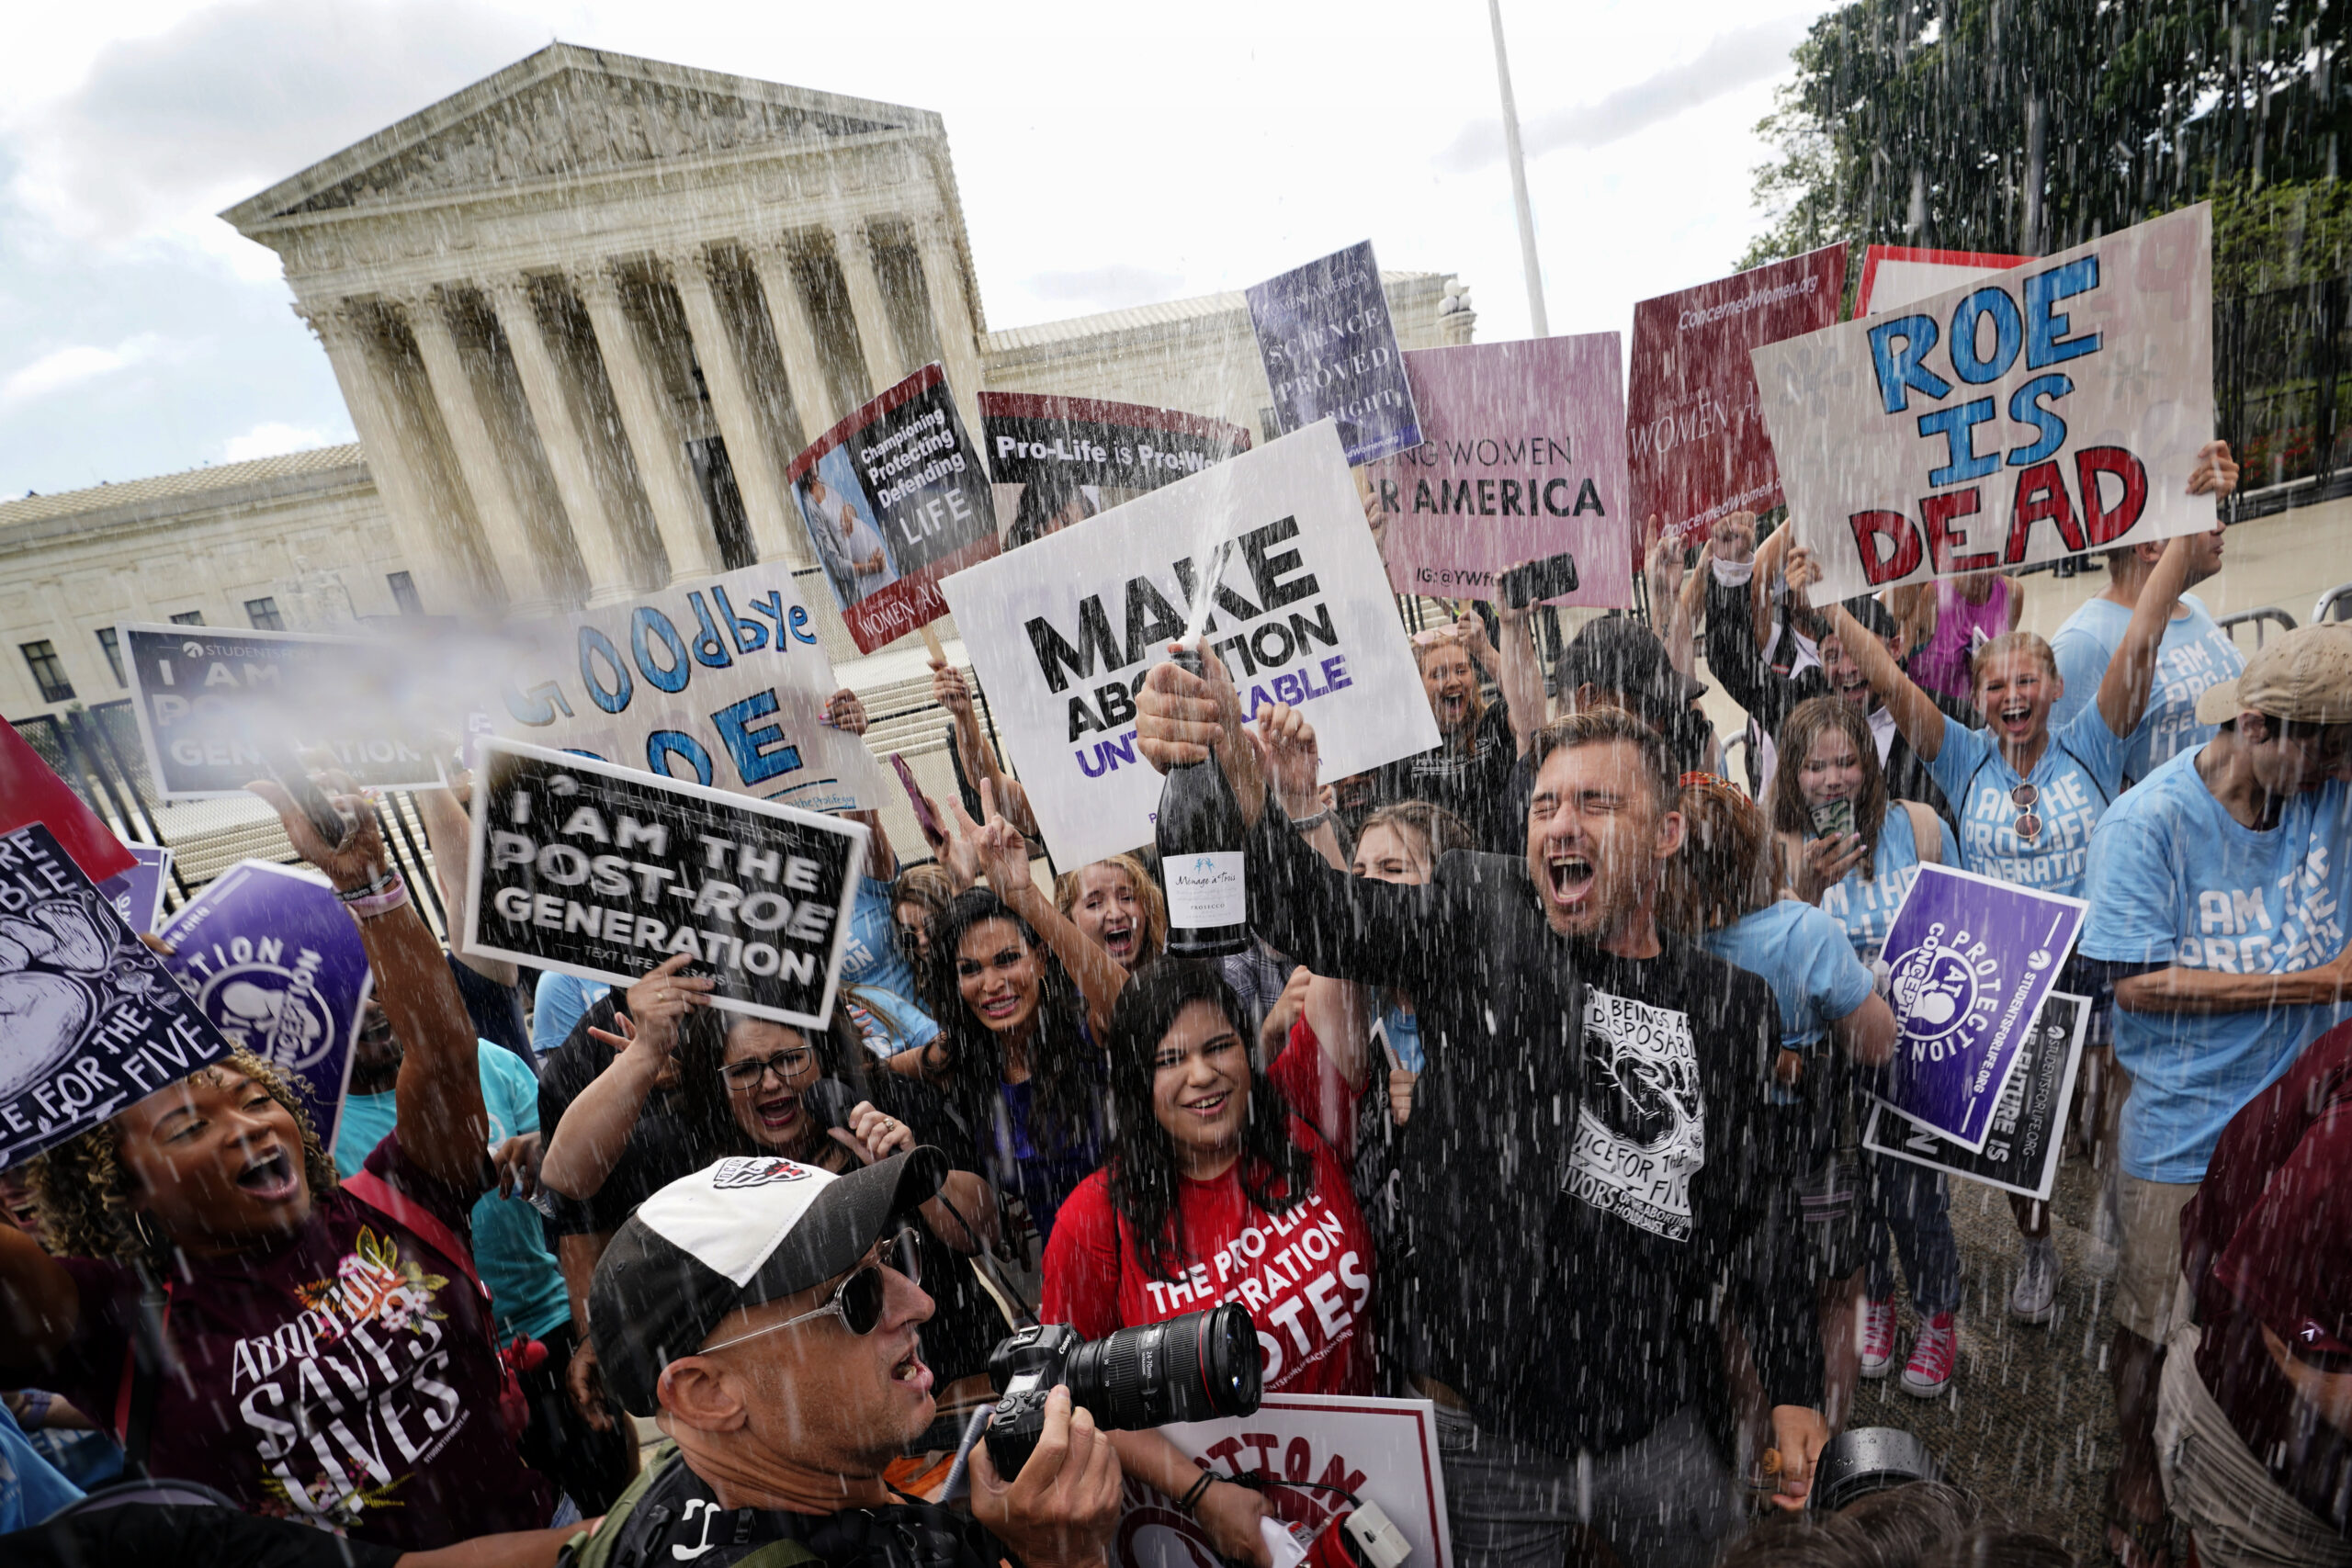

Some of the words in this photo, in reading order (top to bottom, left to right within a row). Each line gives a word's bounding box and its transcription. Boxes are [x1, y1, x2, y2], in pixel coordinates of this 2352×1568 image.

[1678, 274, 1819, 332] ConcernedWomen.org
[1268, 307, 1382, 367] SCIENCE
[1866, 253, 2105, 415] ROE
[1276, 345, 1390, 402] PROVED
[860, 407, 945, 466] Championing
[995, 435, 1108, 464] Pro-Life
[1114, 439, 1134, 467] is
[1136, 443, 1224, 473] Pro-Wo
[1445, 435, 1573, 467] WOMEN
[1630, 393, 1731, 461] WOMEN
[1917, 372, 2075, 489] IS
[868, 428, 955, 487] Protecting
[876, 450, 967, 510] Defending
[899, 487, 972, 547] LIFE
[1412, 477, 1606, 518] AMERICA
[1661, 476, 1783, 540] ConcernedWomen.o
[1848, 444, 2150, 587] DEAD
[857, 595, 916, 640] WOMEN
[1023, 513, 1321, 695] MAKE
[158, 659, 175, 686] I
[1066, 603, 1340, 744] ABTION
[2168, 638, 2213, 677] AM
[170, 737, 422, 768] GENTION
[557, 686, 805, 788] OE
[2041, 770, 2089, 818] HE
[0, 829, 49, 872] RE
[512, 790, 532, 826] I
[560, 805, 670, 858] AM
[697, 832, 823, 895] THE
[491, 829, 837, 945] POST-ROE
[1190, 902, 1226, 911] PROSECCO
[2199, 886, 2273, 936] AM
[493, 886, 819, 987] GENERATION
[583, 944, 619, 962] TEXT
[622, 953, 655, 971] LIFE
[1893, 921, 1946, 1054] CONCEPTION
[1910, 929, 2002, 1063] PROTECTION
[1940, 964, 1968, 998] AT
[1592, 1007, 1697, 1060] DISPOSABL
[1611, 998, 1670, 1030] BEINGS
[1972, 970, 2037, 1094] STUDENTSFORLIFE.ORG
[31, 1055, 120, 1121] FOR
[92, 1002, 153, 1055] THE
[121, 1011, 222, 1093] FIVE
[2022, 1038, 2062, 1158] STUDENTSFORLIFE.ORG
[1617, 1146, 1655, 1183] FOR
[1985, 1138, 2012, 1164] IS
[1146, 1262, 1216, 1315] THE
[1213, 1186, 1323, 1283] PRO-LIFE
[1058, 1333, 1072, 1355] Canon
[1257, 1250, 1372, 1385] OTES
[239, 1285, 444, 1461] SAVES
[271, 1348, 461, 1540] LIVES
